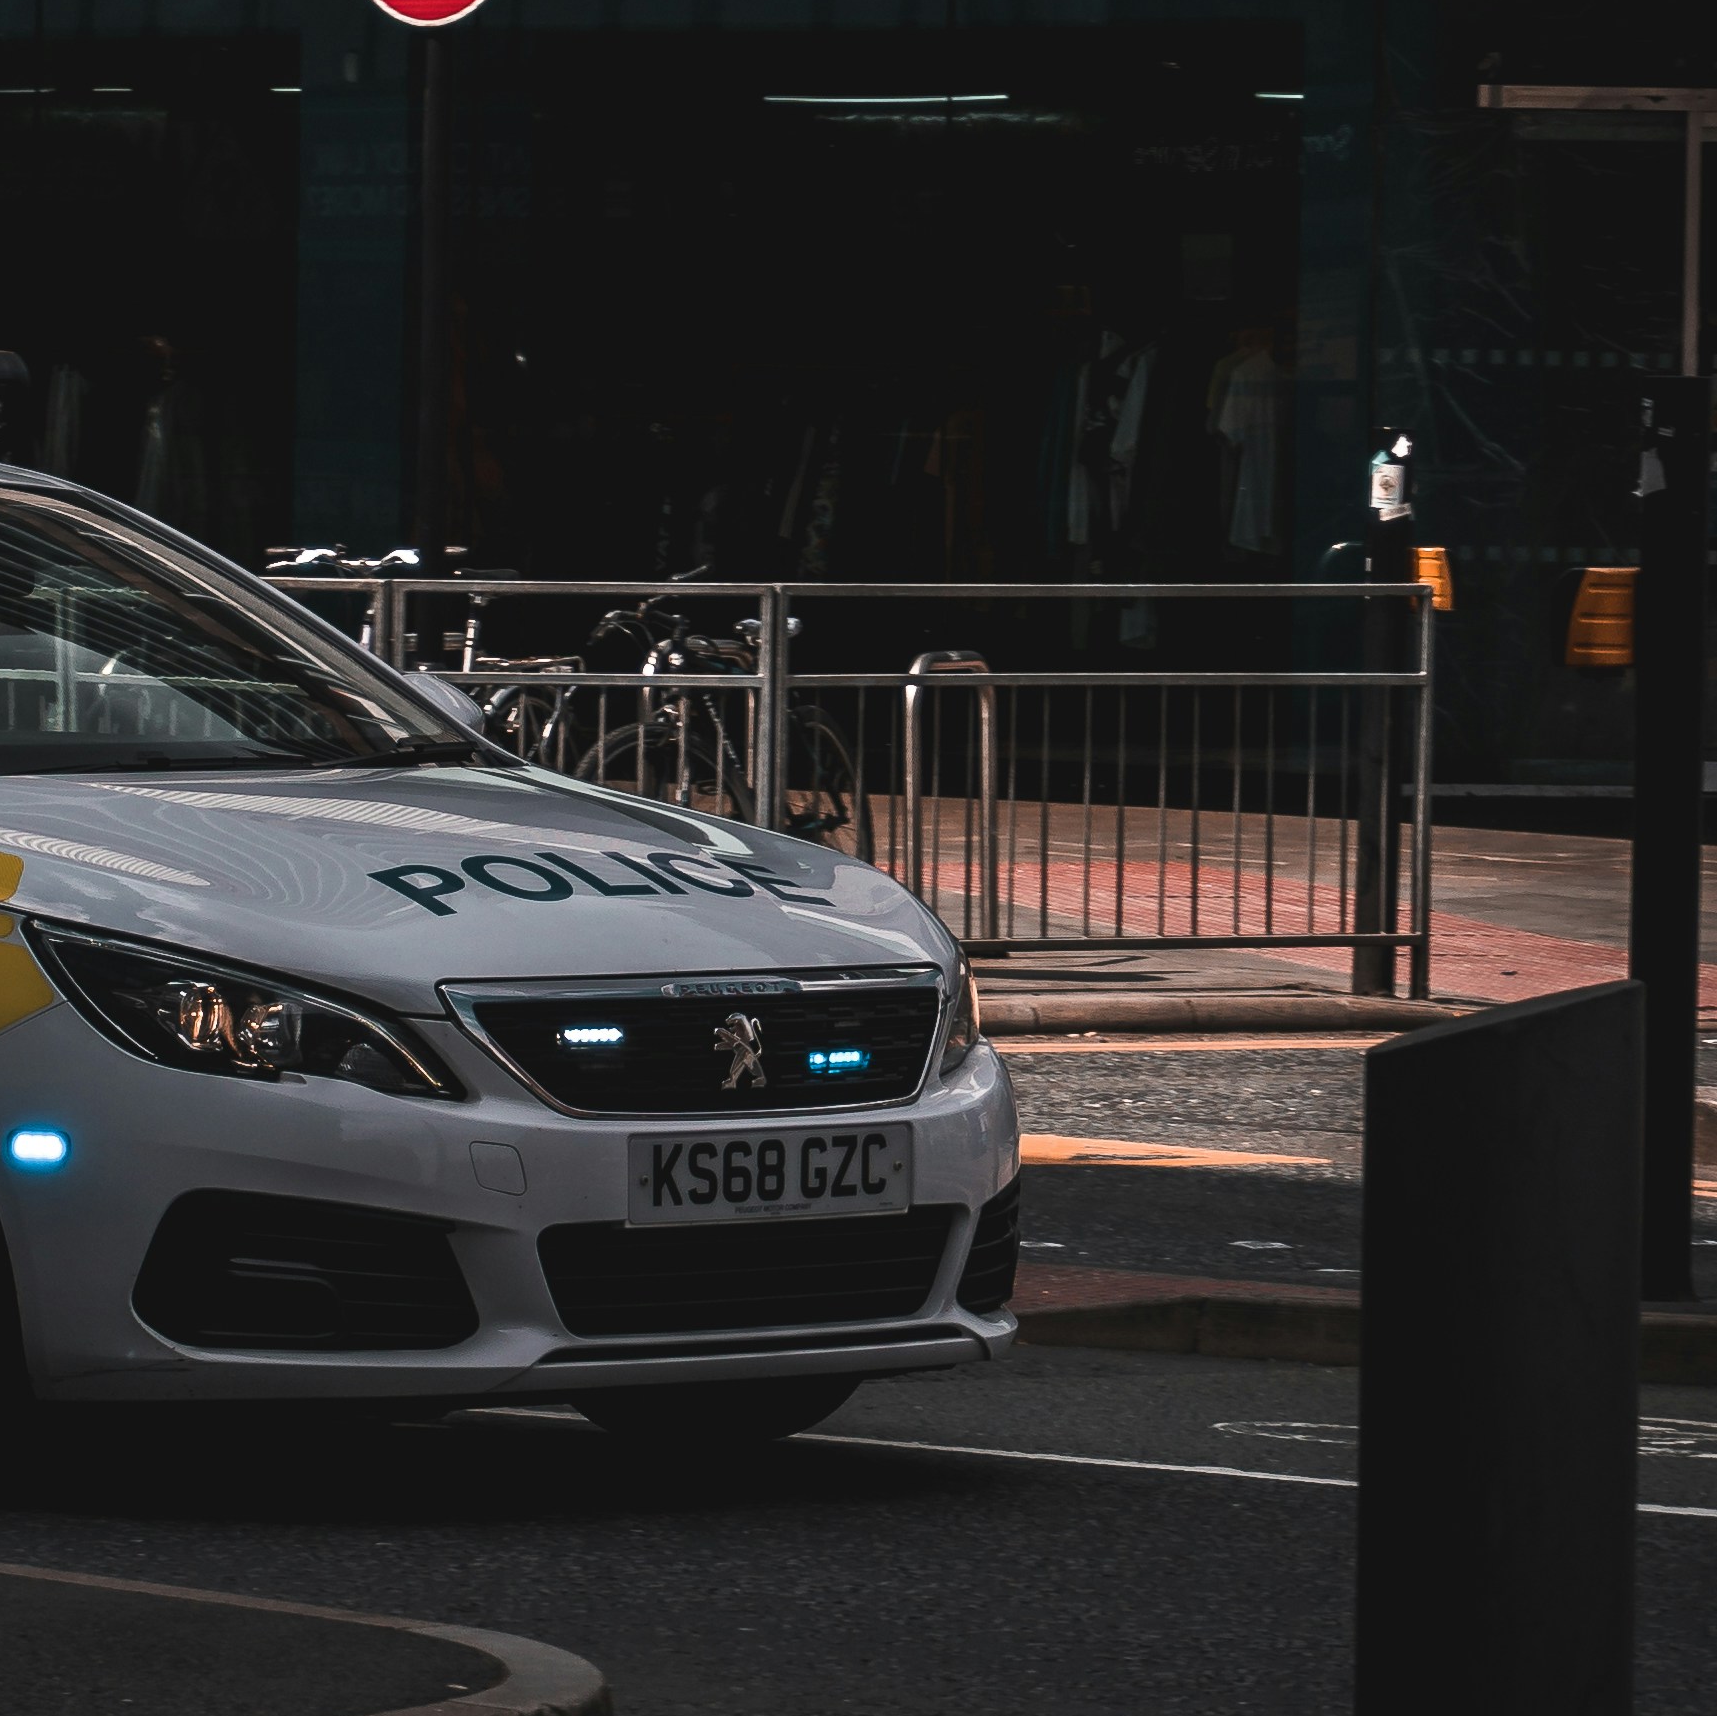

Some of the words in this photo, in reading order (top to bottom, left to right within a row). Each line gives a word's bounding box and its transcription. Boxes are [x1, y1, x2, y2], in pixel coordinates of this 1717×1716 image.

[368, 851, 836, 916] POLICE
[681, 982, 781, 996] PEUGEOT
[652, 1139, 785, 1206] KS68
[800, 1134, 887, 1199] GZC
